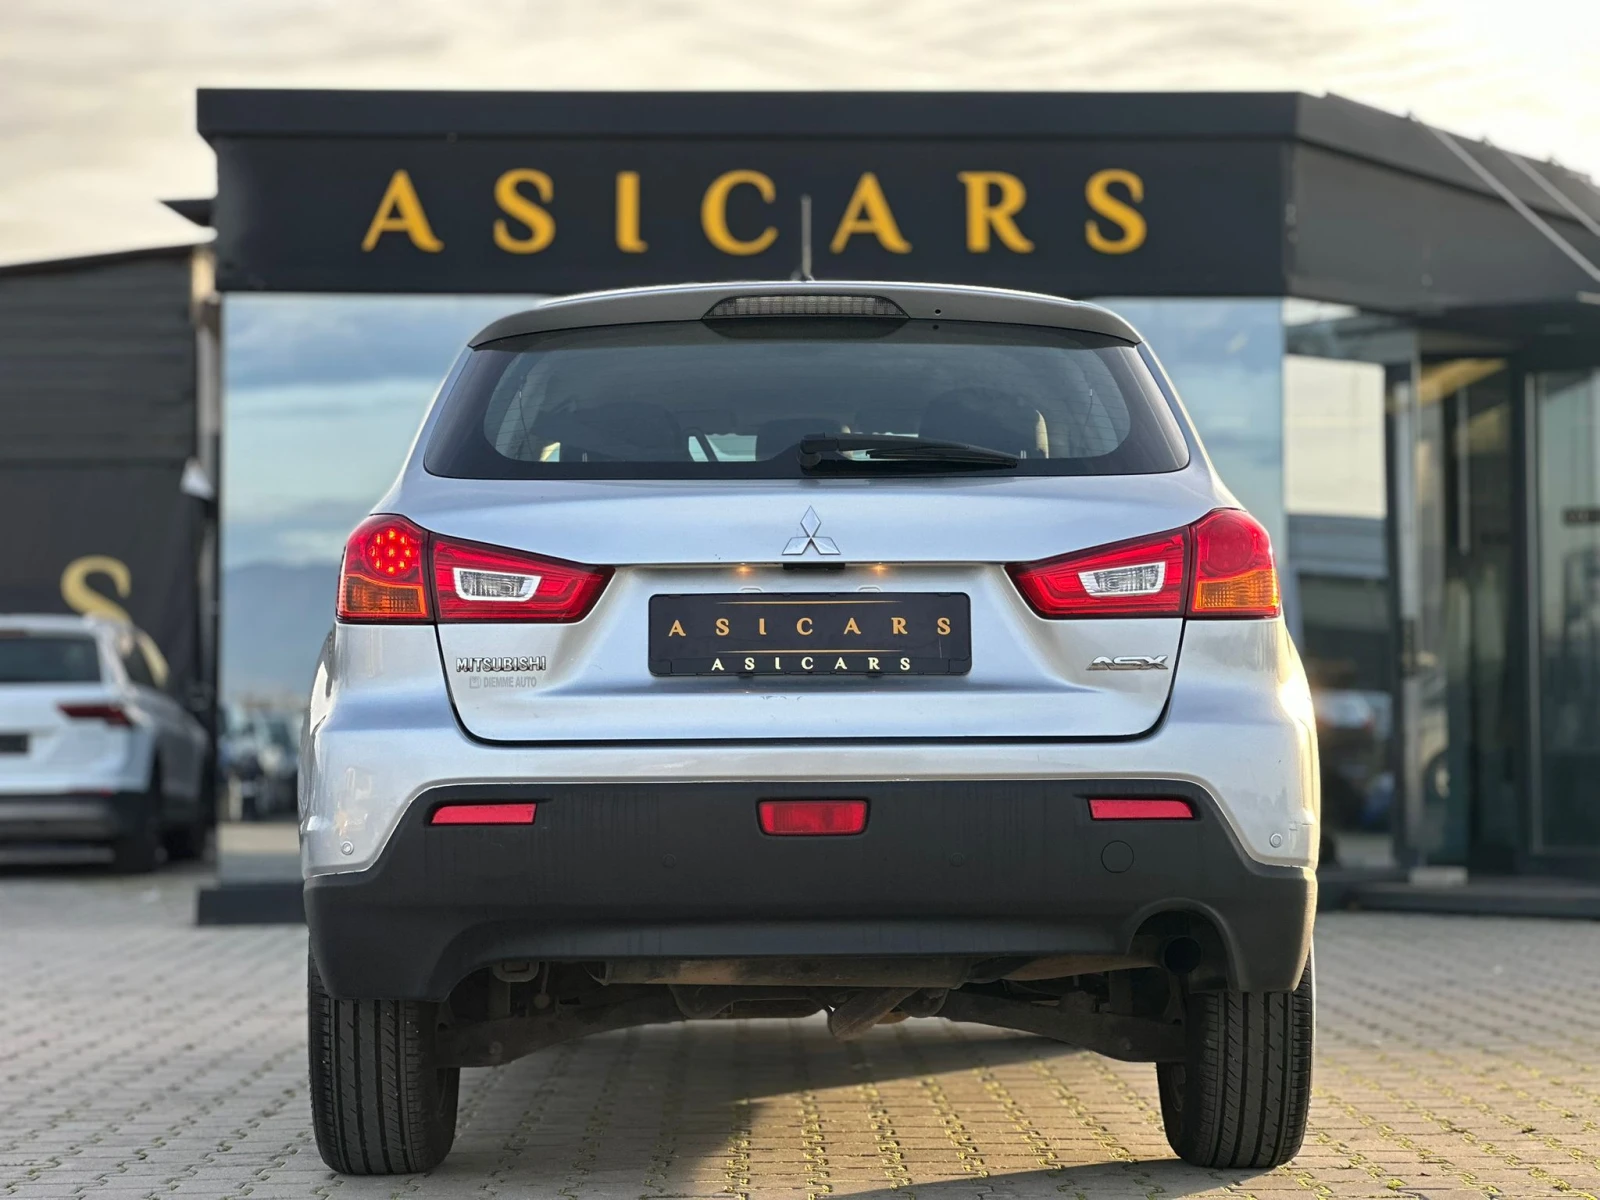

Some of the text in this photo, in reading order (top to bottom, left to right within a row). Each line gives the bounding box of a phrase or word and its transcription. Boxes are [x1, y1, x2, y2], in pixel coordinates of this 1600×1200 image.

[361, 168, 1148, 256] ASICARS
[668, 617, 951, 637] ASICARS
[456, 656, 546, 672] MITSUBISHI
[711, 657, 911, 671] ASICARS
[1085, 655, 1168, 670] ASX
[483, 676, 537, 688] DIEMME AUTO
